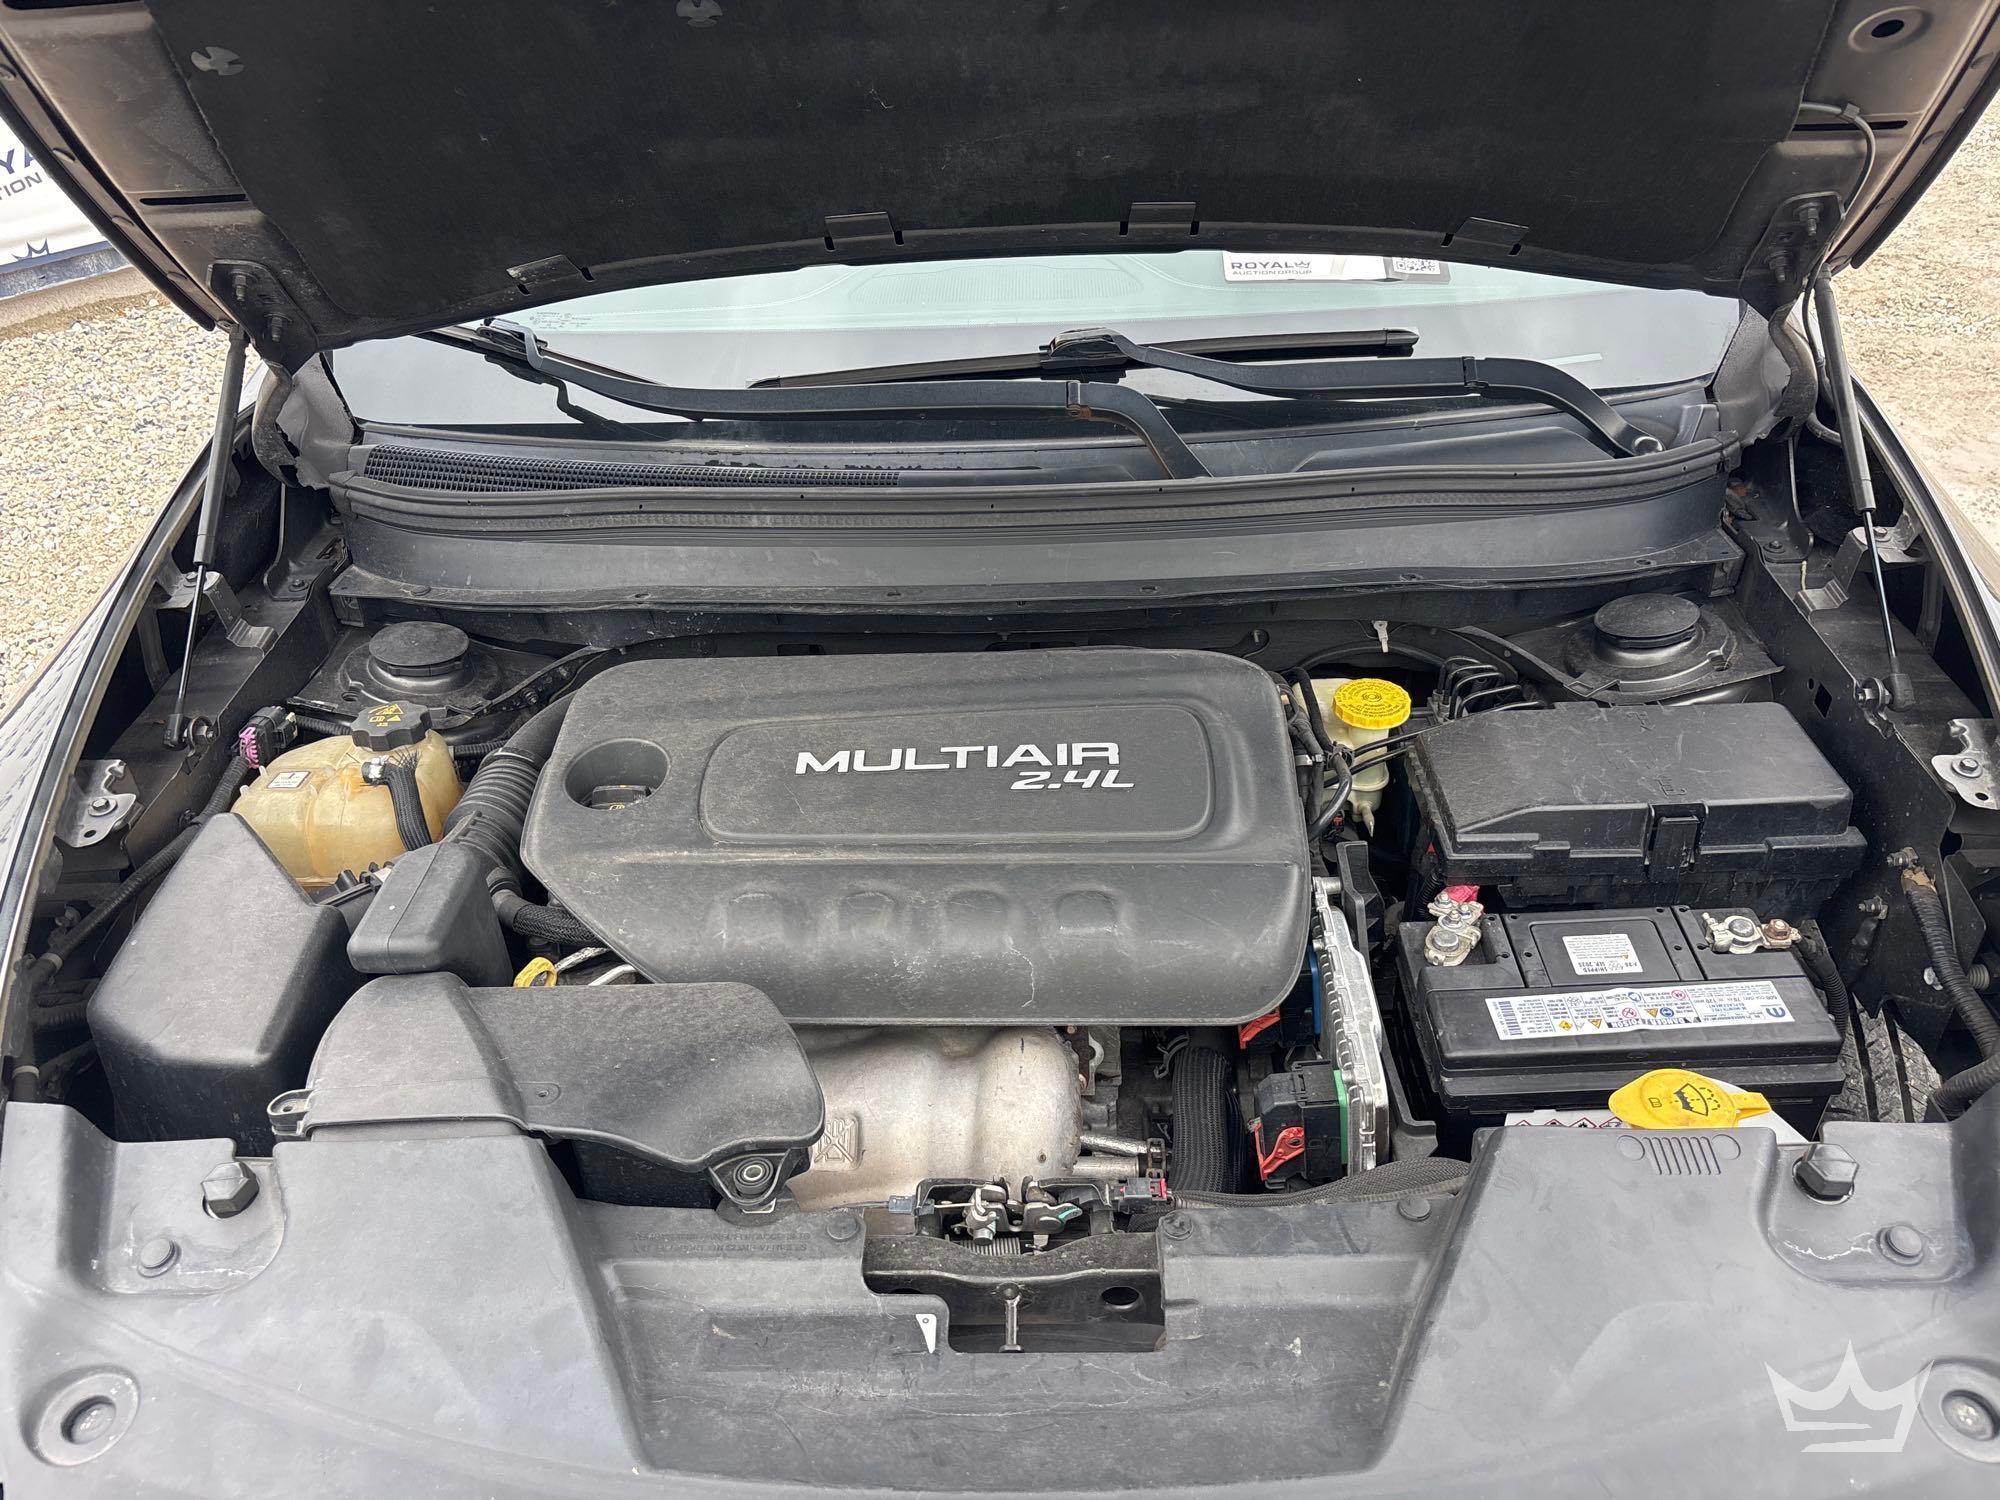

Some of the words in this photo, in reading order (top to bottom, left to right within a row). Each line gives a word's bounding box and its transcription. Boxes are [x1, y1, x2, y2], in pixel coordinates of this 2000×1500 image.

[1231, 261, 1294, 270] ROYAL
[795, 742, 1120, 775] MULTIAIR
[1010, 769, 1135, 791] 2.4L
